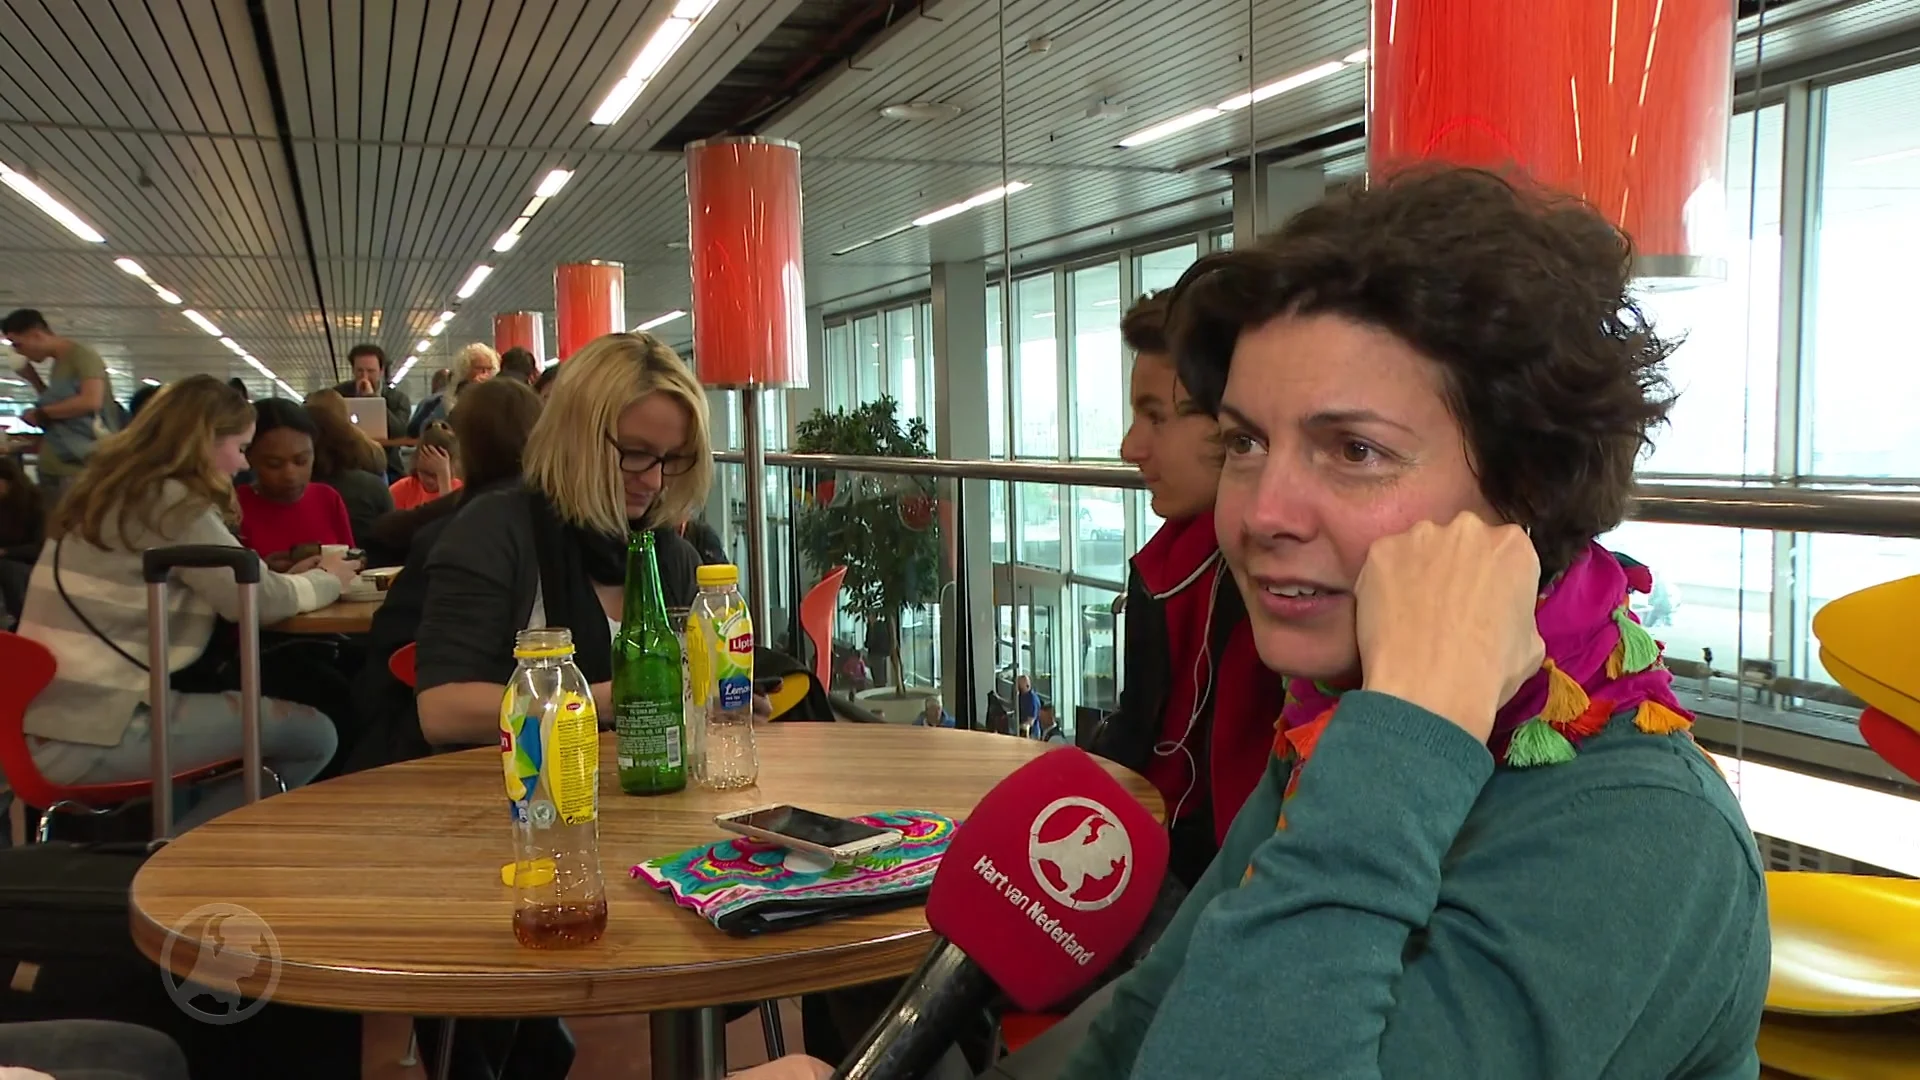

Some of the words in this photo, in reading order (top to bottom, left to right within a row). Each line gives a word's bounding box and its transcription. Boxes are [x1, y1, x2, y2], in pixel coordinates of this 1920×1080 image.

[725, 683, 750, 696] Lemo
[973, 855, 1009, 890] Hart
[1004, 884, 1030, 911] van
[1027, 901, 1094, 965] Nederland
